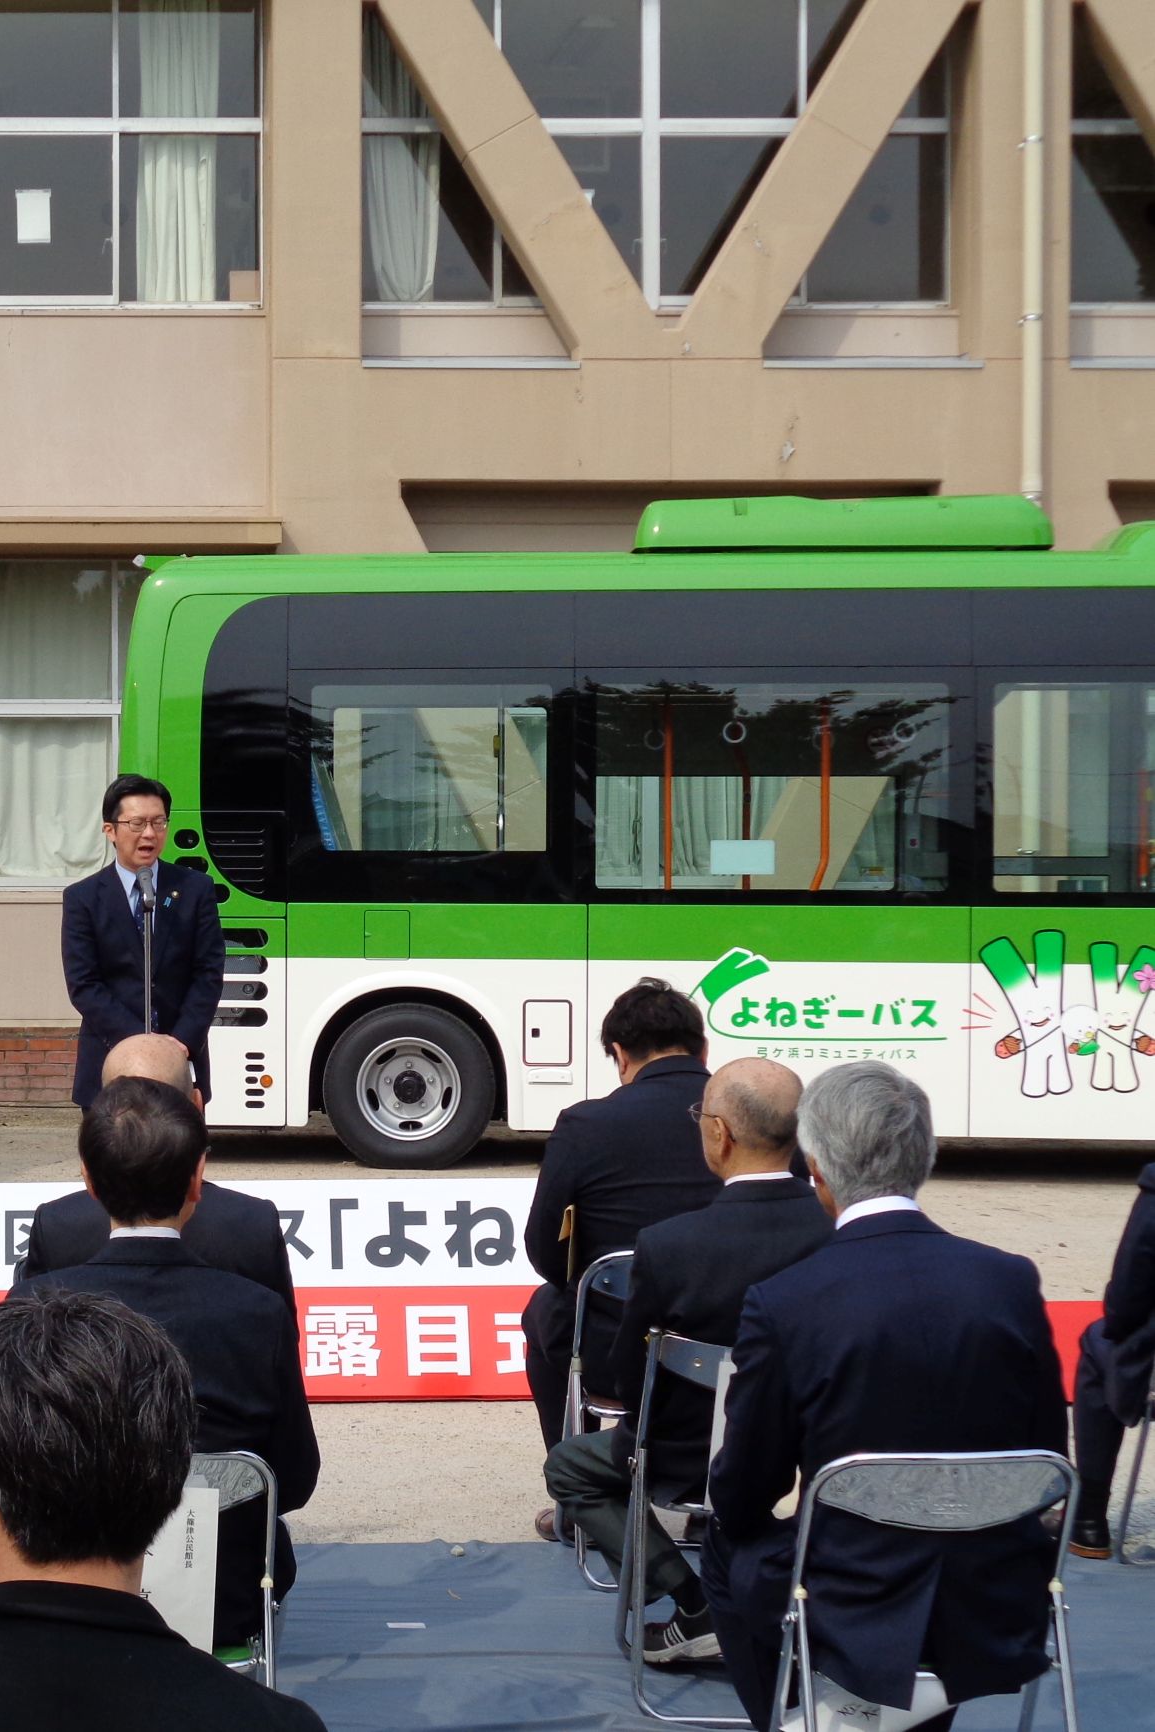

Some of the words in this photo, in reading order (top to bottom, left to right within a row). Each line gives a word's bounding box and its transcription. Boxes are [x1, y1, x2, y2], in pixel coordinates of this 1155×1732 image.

[730, 995, 938, 1030] よねぎーバス
